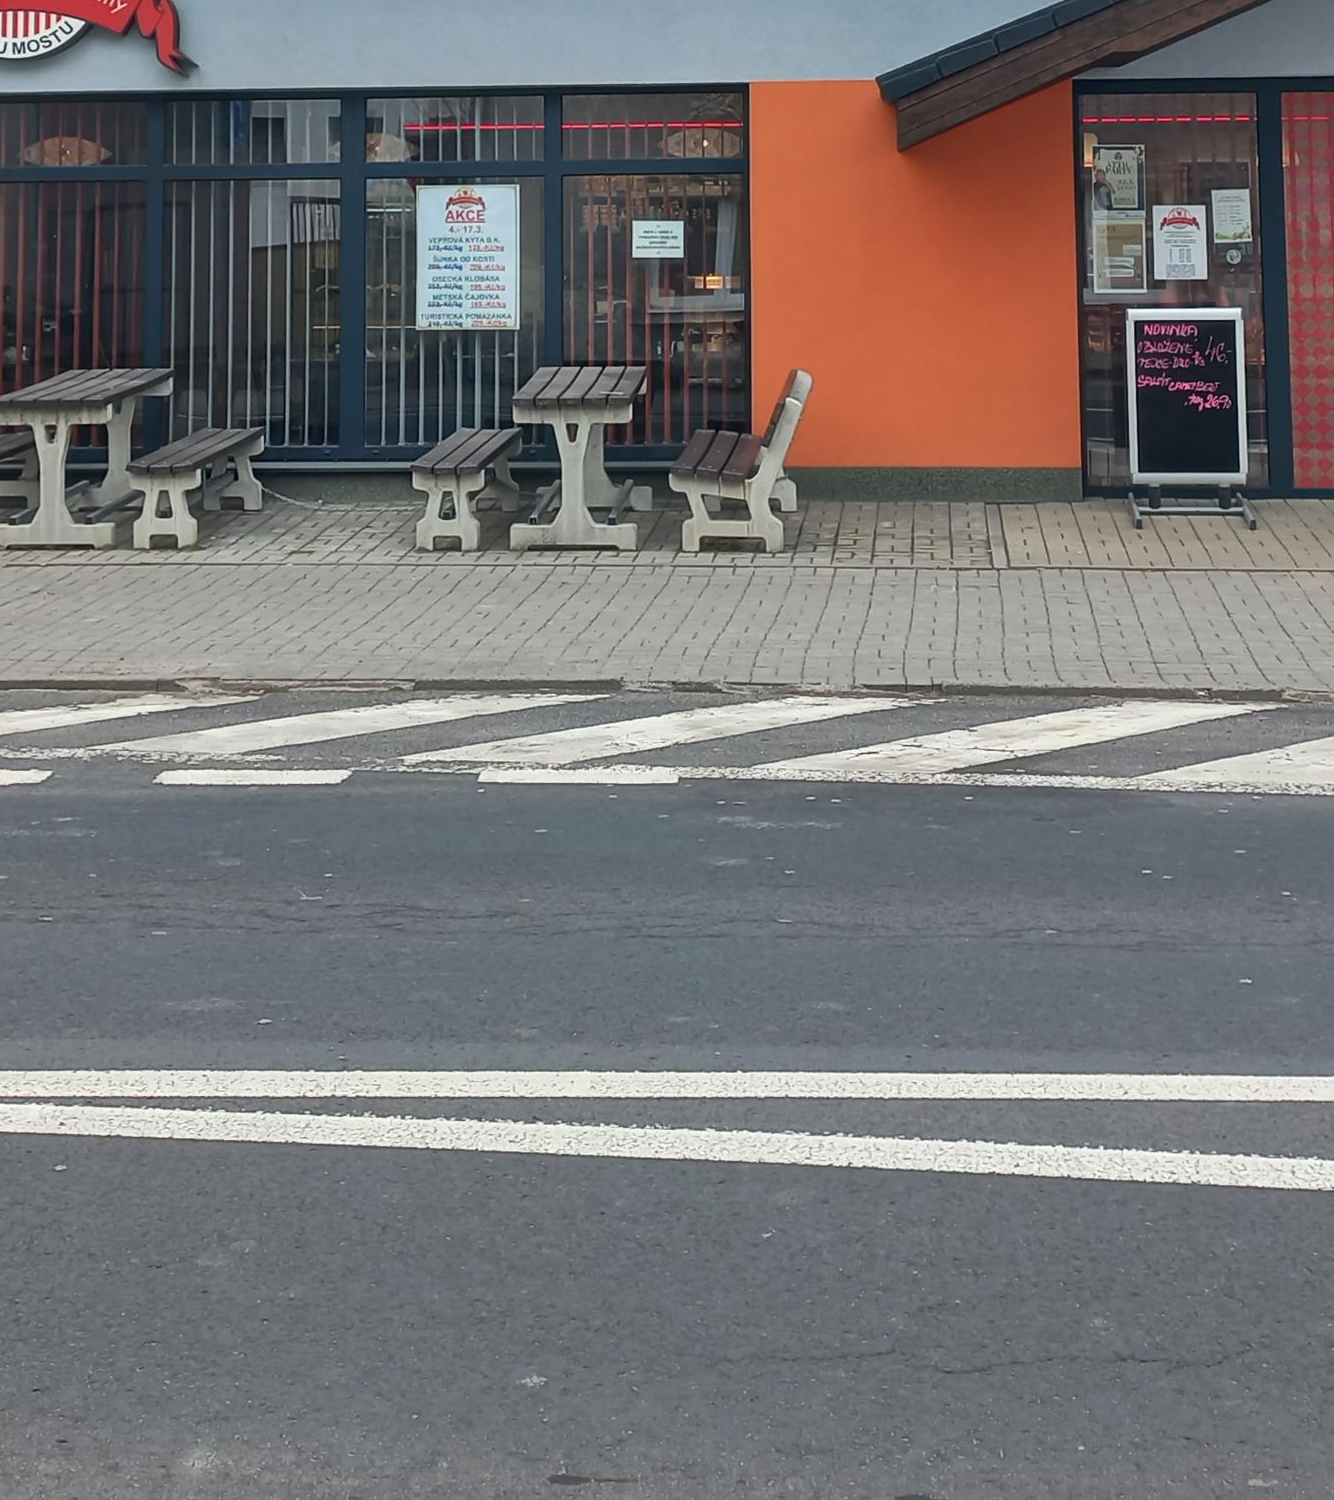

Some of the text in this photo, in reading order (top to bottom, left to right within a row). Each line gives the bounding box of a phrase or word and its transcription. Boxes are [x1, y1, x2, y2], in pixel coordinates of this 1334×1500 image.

[11, 22, 74, 55] MOSTU
[447, 209, 485, 221] AKCE
[1143, 324, 1199, 336] NOVINKA
